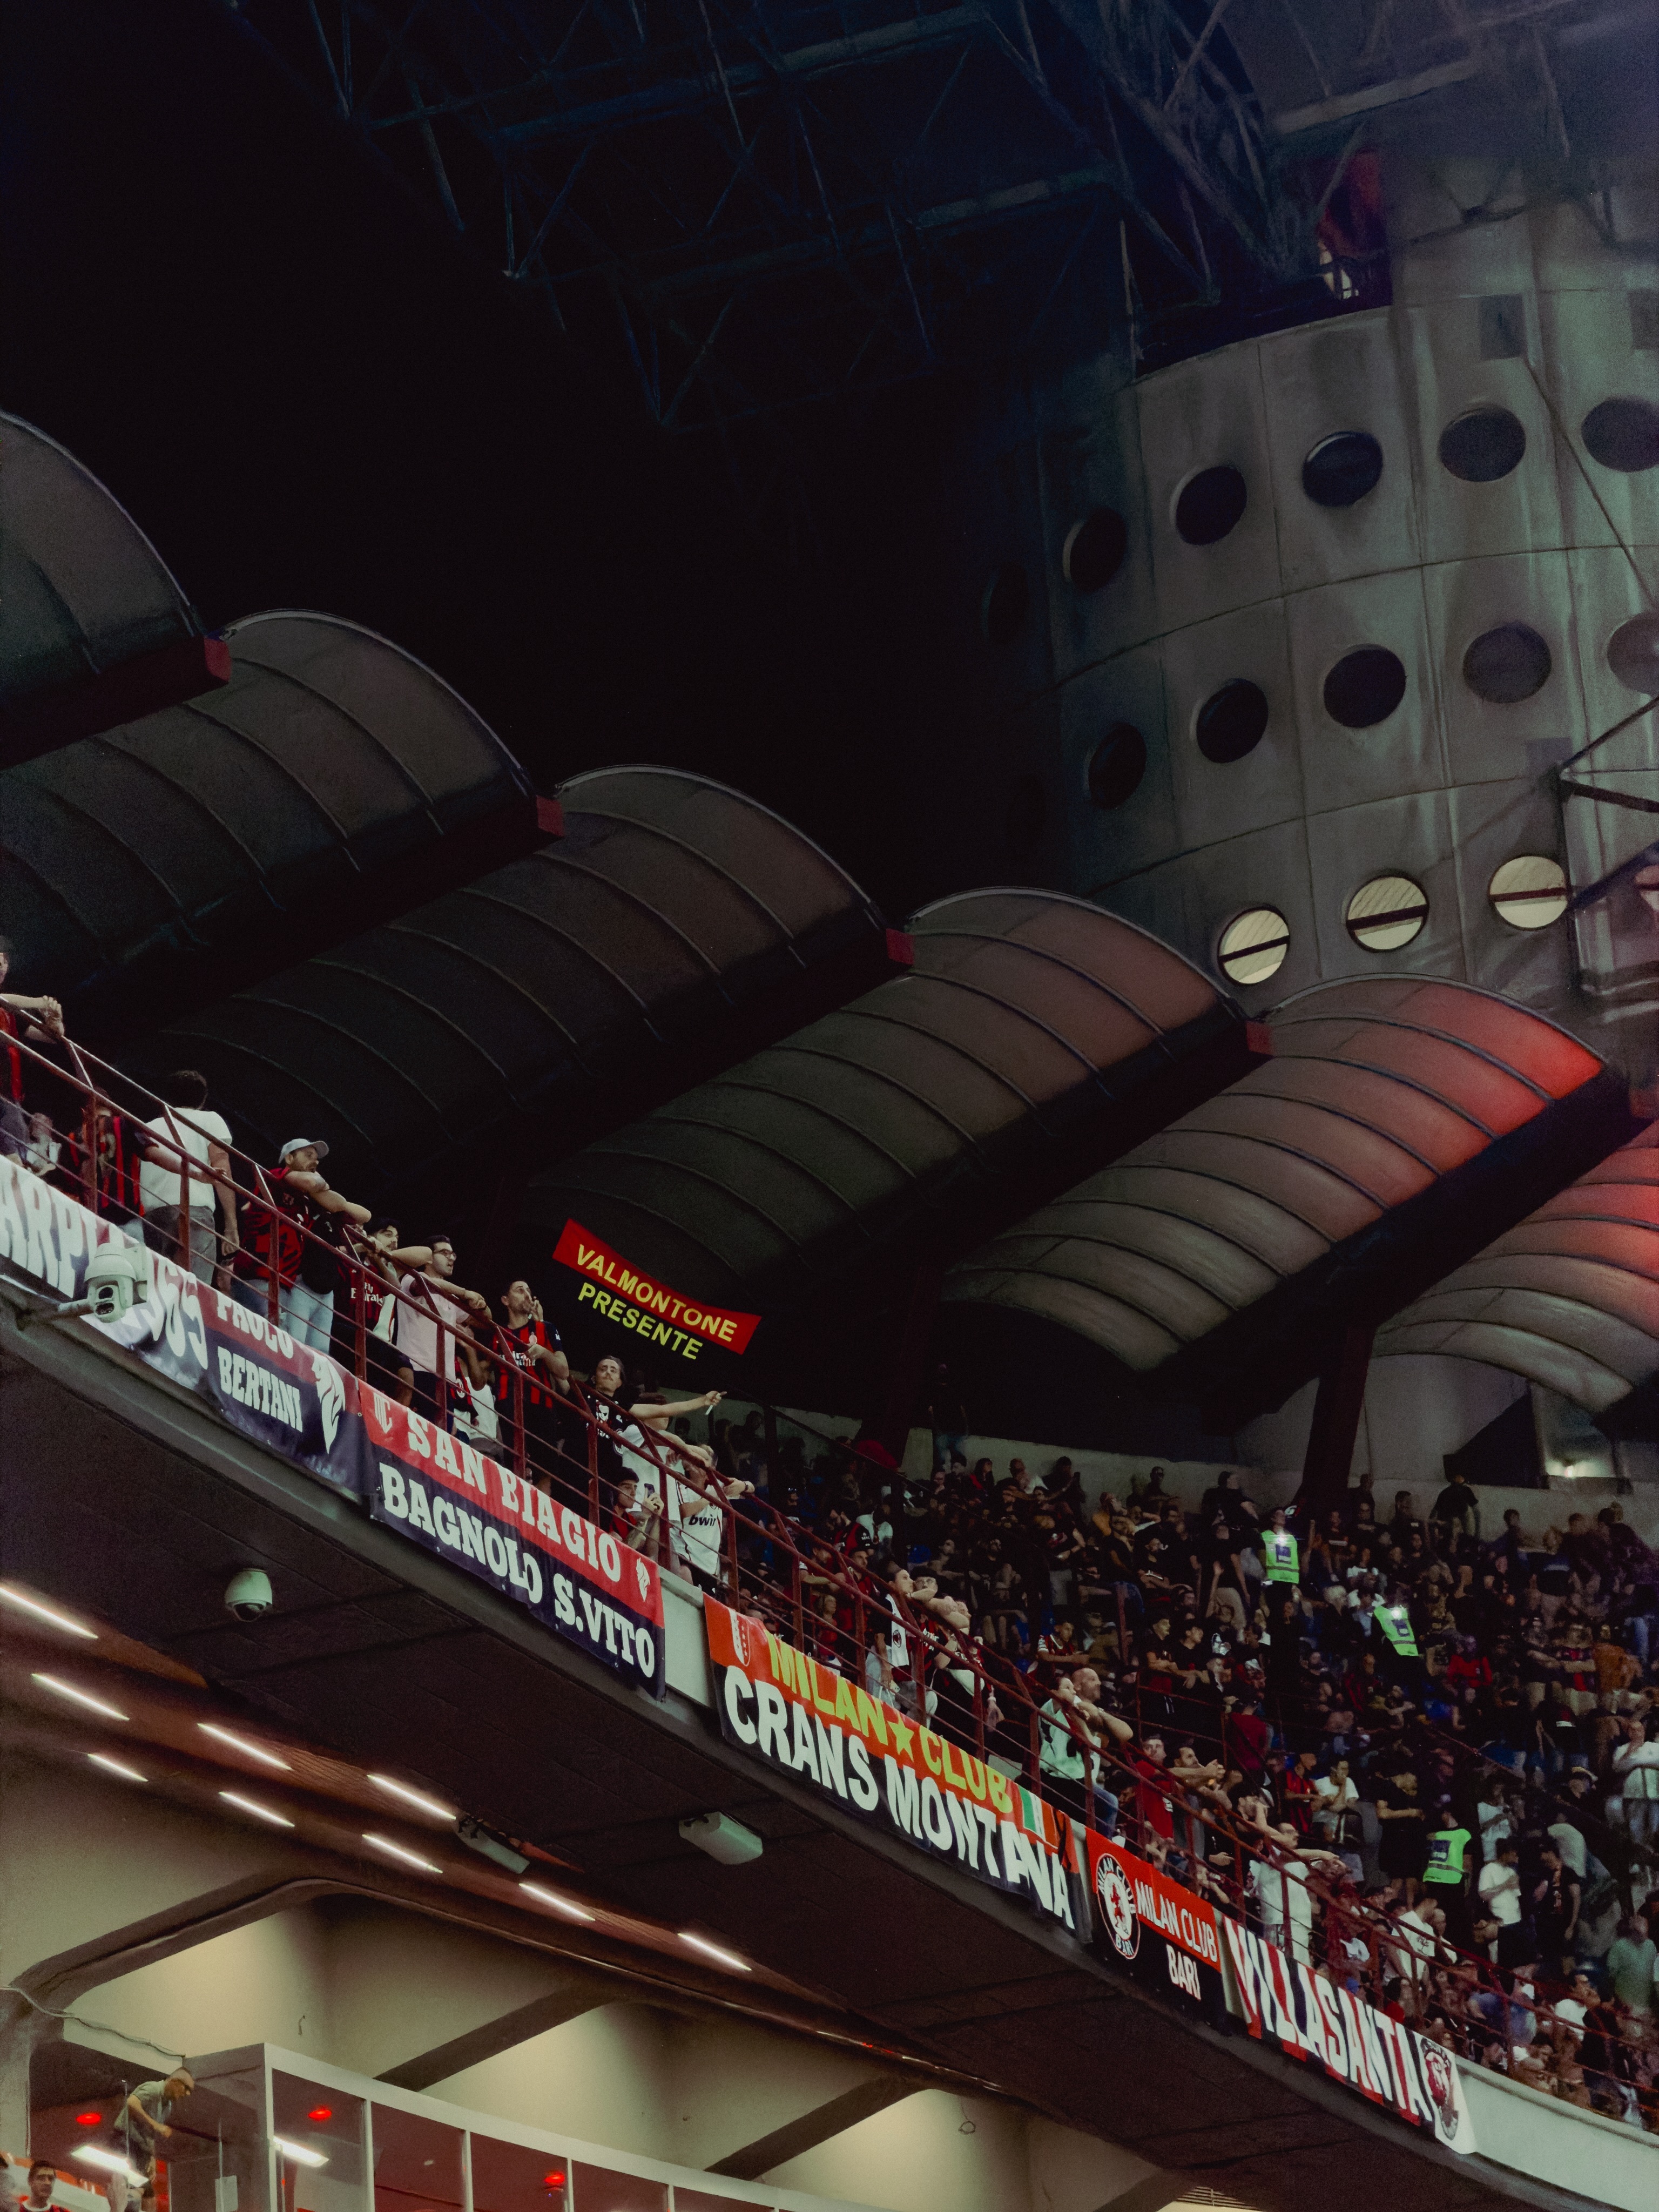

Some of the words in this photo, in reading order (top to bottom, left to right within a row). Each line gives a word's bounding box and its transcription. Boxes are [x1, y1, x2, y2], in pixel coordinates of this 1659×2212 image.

[577, 1244, 737, 1342] VALMONTONE
[578, 1282, 703, 1359] PRESENTE
[218, 1346, 302, 1432] BERTANI
[408, 1407, 487, 1495] SAN
[502, 1465, 621, 1583] BIAGIO
[379, 1462, 543, 1604] BAGNOLO
[555, 1573, 655, 1678] S.VITO
[765, 1628, 888, 1745] MILAN
[920, 1724, 1013, 1813] CLUB
[725, 1665, 879, 1811] CRANS
[884, 1753, 1075, 1930] MONTANA
[1135, 1878, 1181, 1939] MILAN
[1181, 1908, 1217, 1962] CLUB
[1166, 1944, 1201, 2000] BARI
[1224, 1916, 1432, 2122] VILLASANTA
